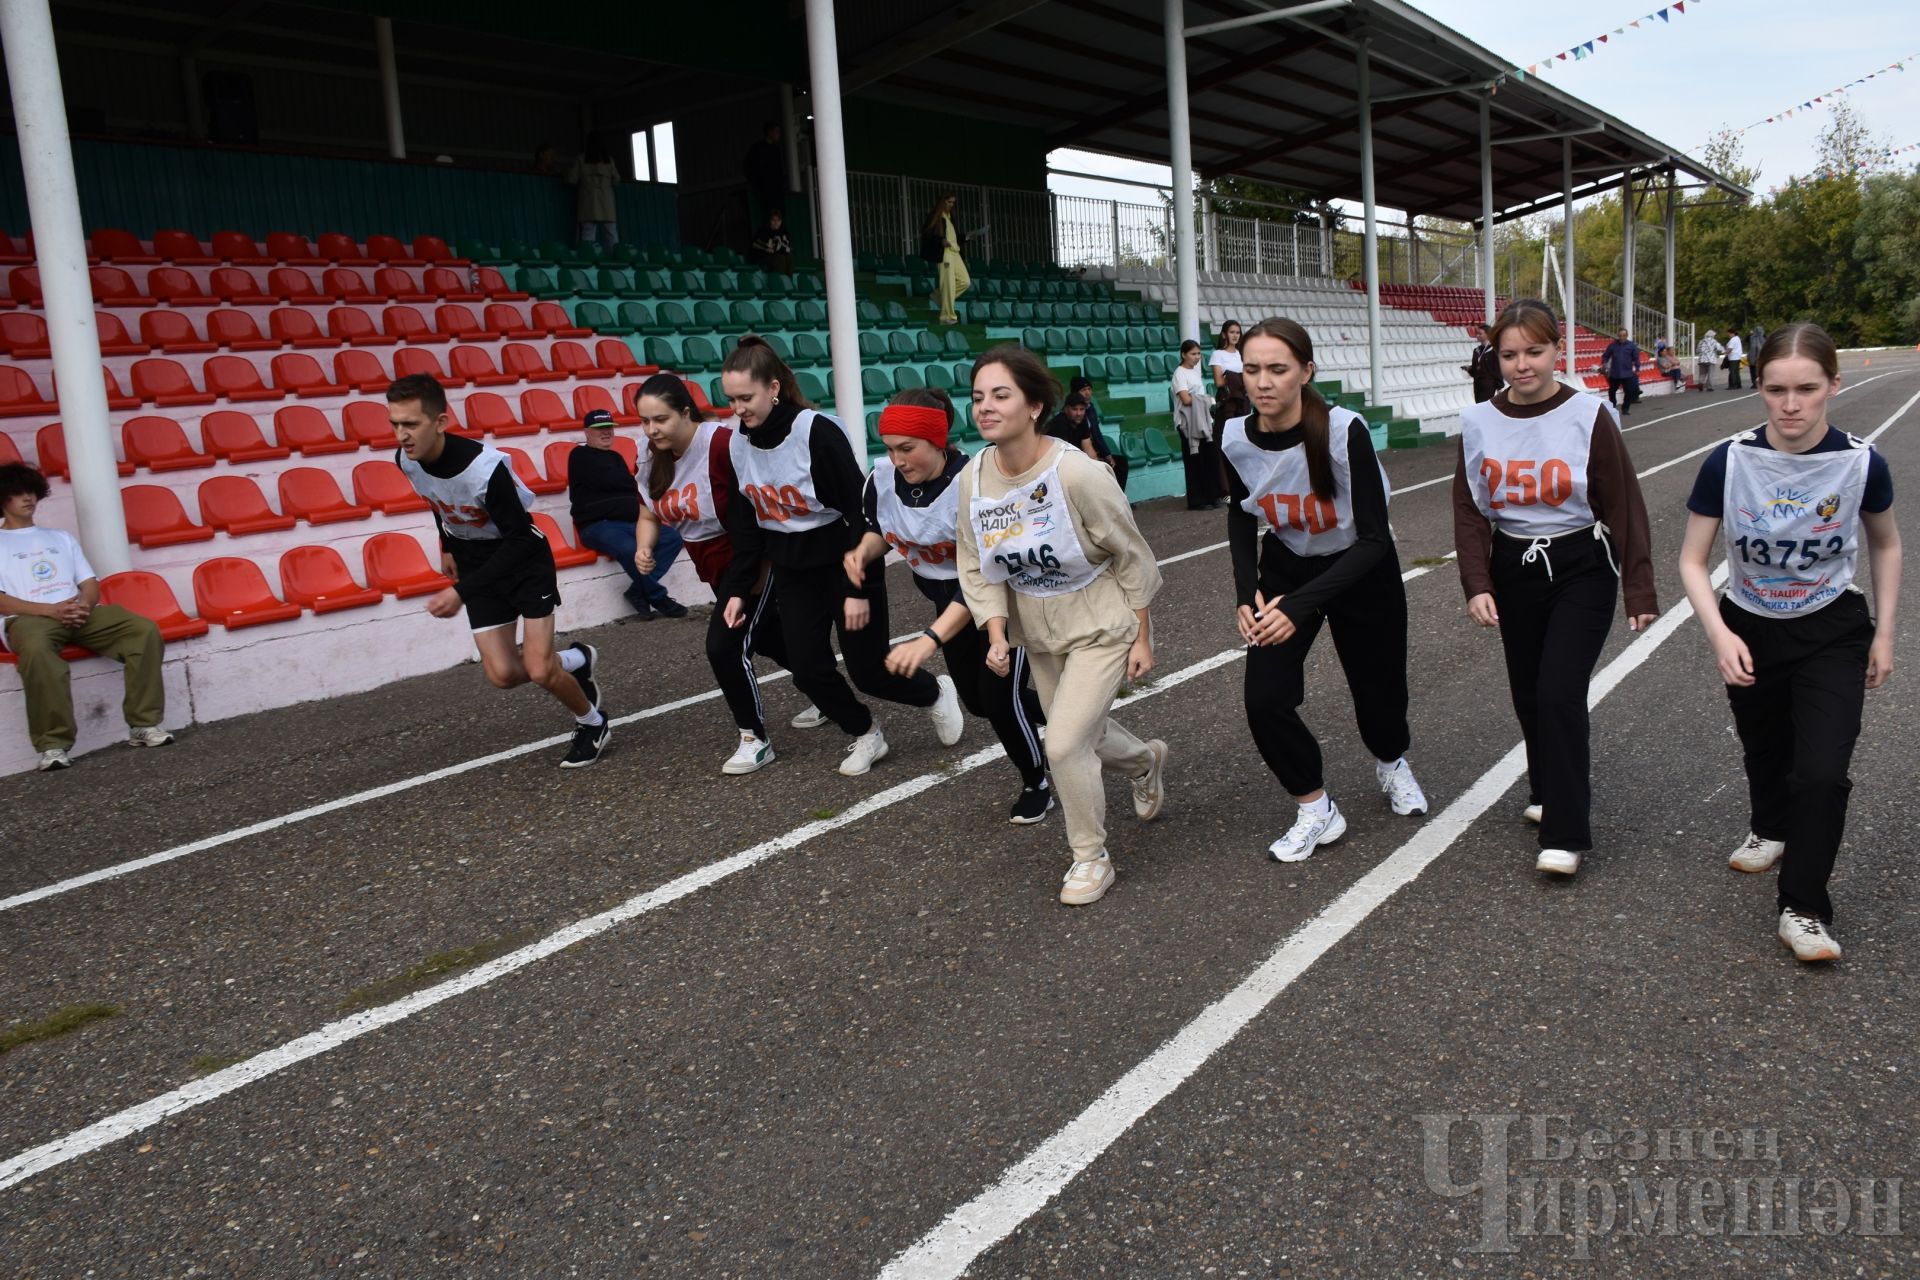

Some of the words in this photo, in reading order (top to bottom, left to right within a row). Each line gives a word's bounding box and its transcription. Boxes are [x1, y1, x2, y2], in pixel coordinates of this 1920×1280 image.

[1480, 457, 1573, 510] 250
[1257, 491, 1338, 535] 170
[1770, 588, 1808, 599] НАЦИИ
